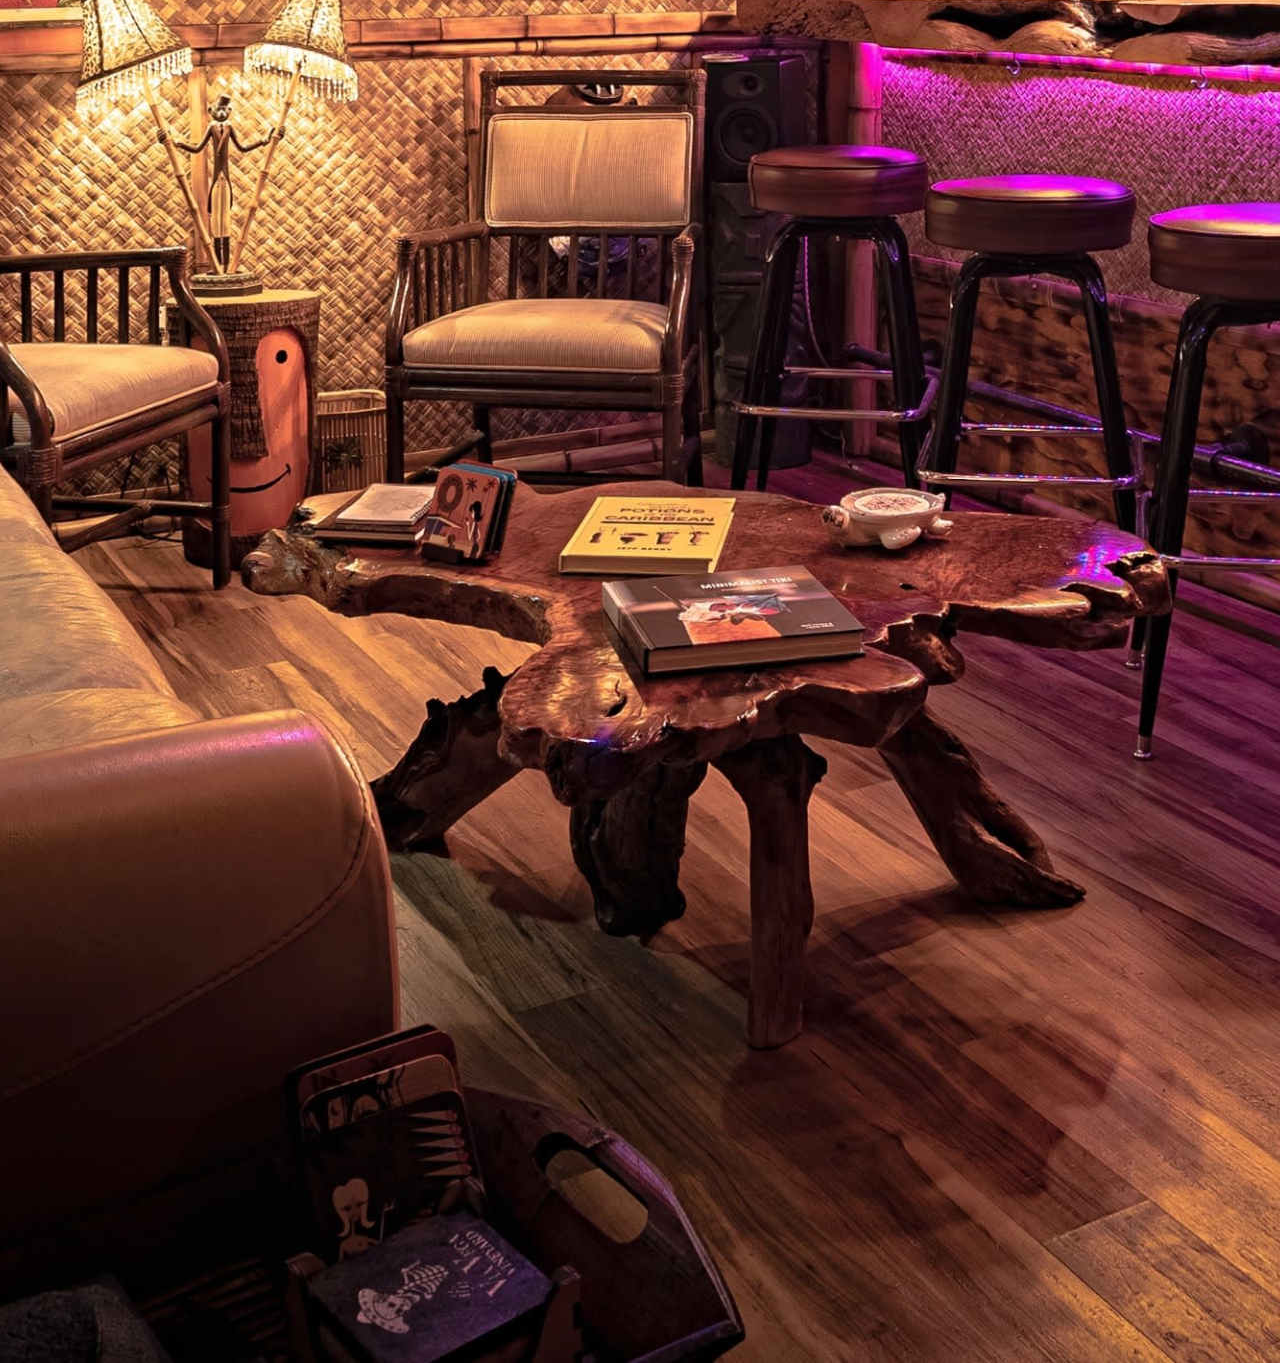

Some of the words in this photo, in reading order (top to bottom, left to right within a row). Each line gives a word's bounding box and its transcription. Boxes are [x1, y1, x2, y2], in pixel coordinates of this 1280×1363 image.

[620, 507, 705, 515] POTIONS
[604, 515, 715, 523] CARIBBEAN
[700, 577, 768, 590] MINIMALIST
[770, 576, 793, 584] TIKI
